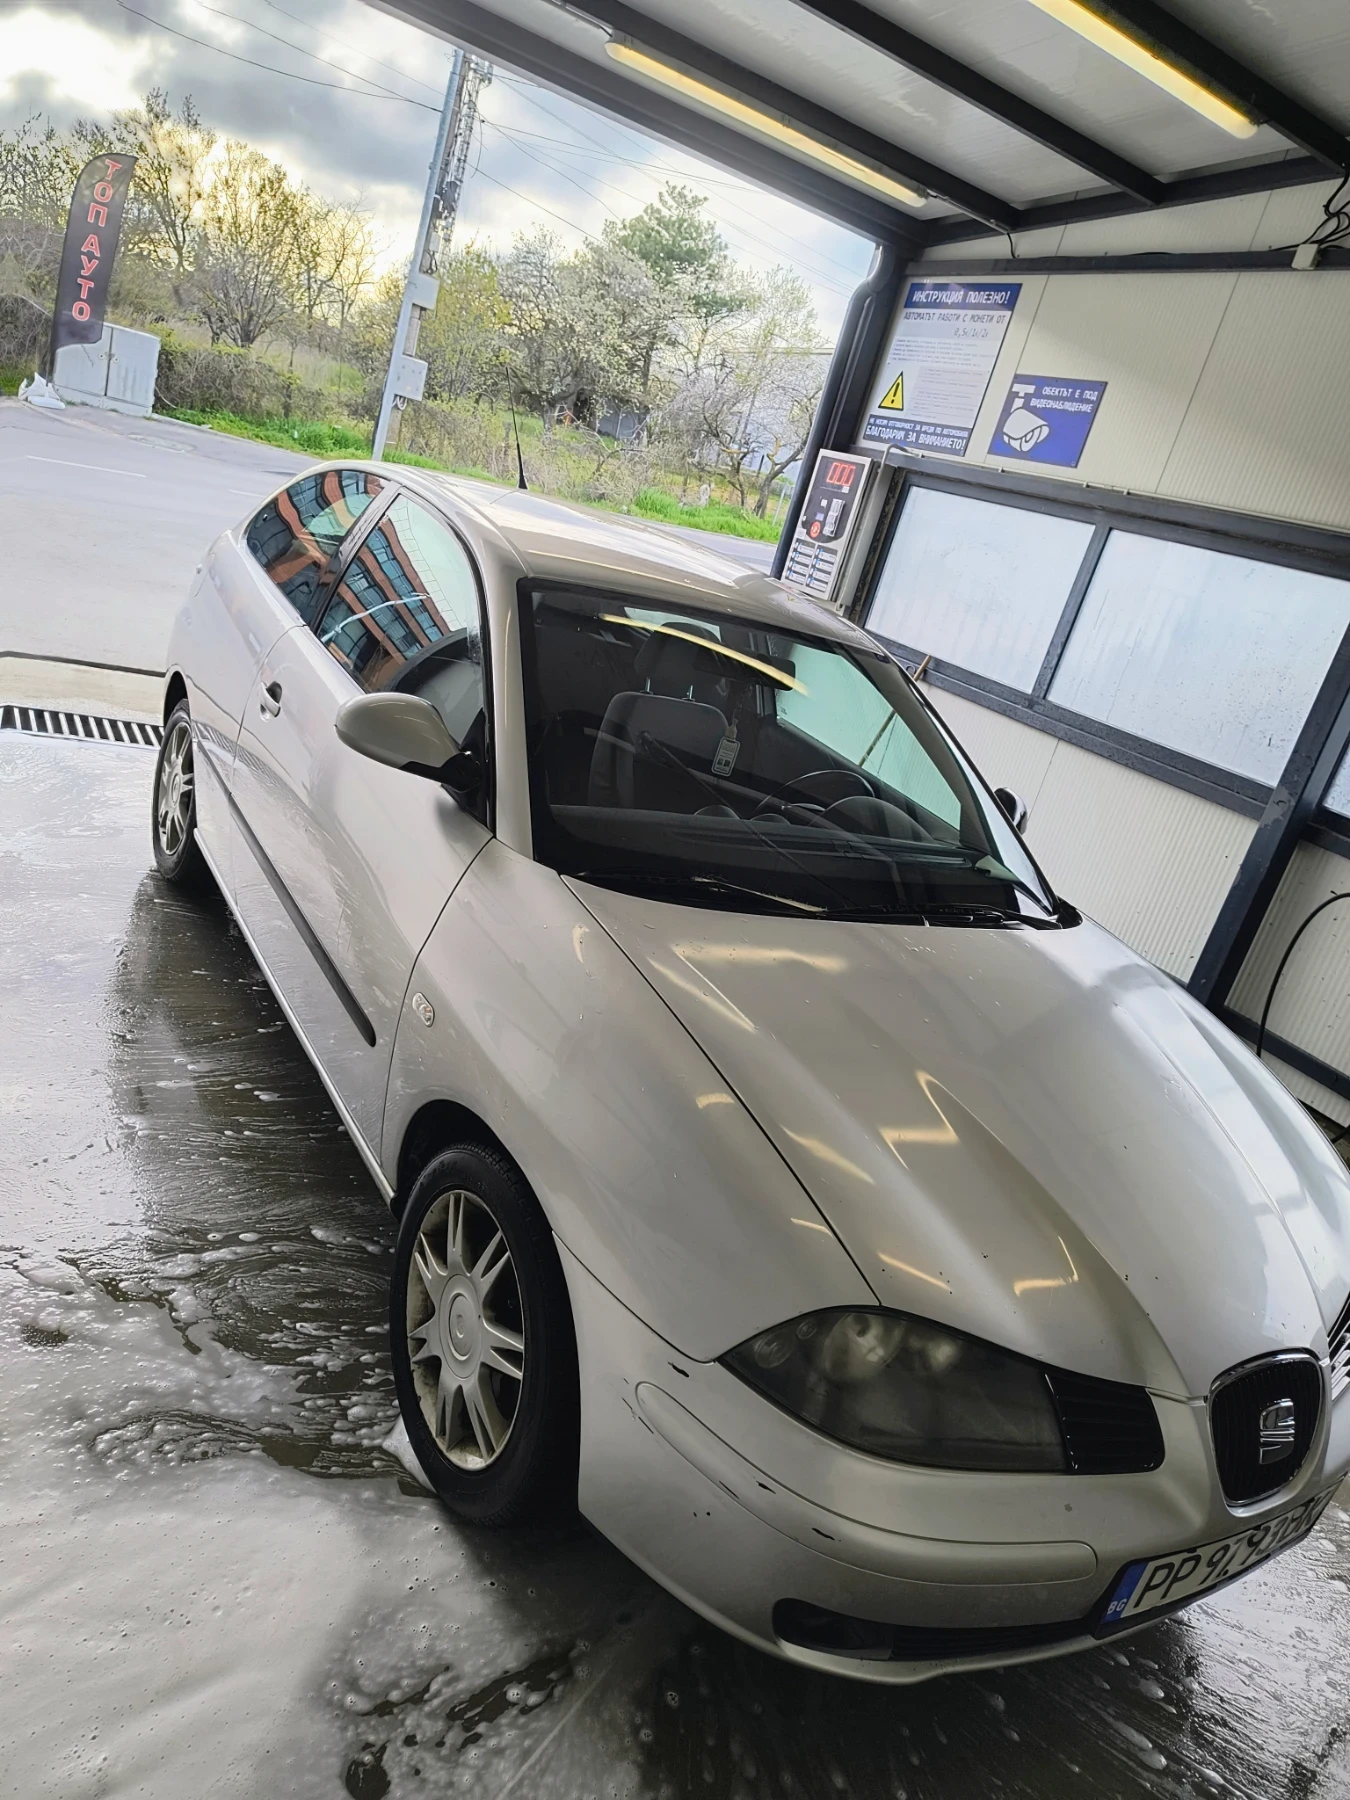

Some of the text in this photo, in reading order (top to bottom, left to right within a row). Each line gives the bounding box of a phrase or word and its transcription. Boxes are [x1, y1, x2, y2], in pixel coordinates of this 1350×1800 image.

[71, 159, 122, 322] ТОП АУТО
[912, 290, 1011, 305] ИНСТРУКЦИЯ ПОЛЕЗНО!
[903, 311, 1006, 324] АВТОМАТЪТ РАБОТИ С МОНЕТИ ОТ
[1042, 386, 1098, 401] ОБЕКТЪТ Е ПОД
[1030, 397, 1093, 412] ВИДЕОНАБЛЮДЕНИЕ
[866, 425, 967, 450] БЛАГОДАРИМ ЗА ВНИМАНИЕТО!
[1107, 1598, 1127, 1615] BG
